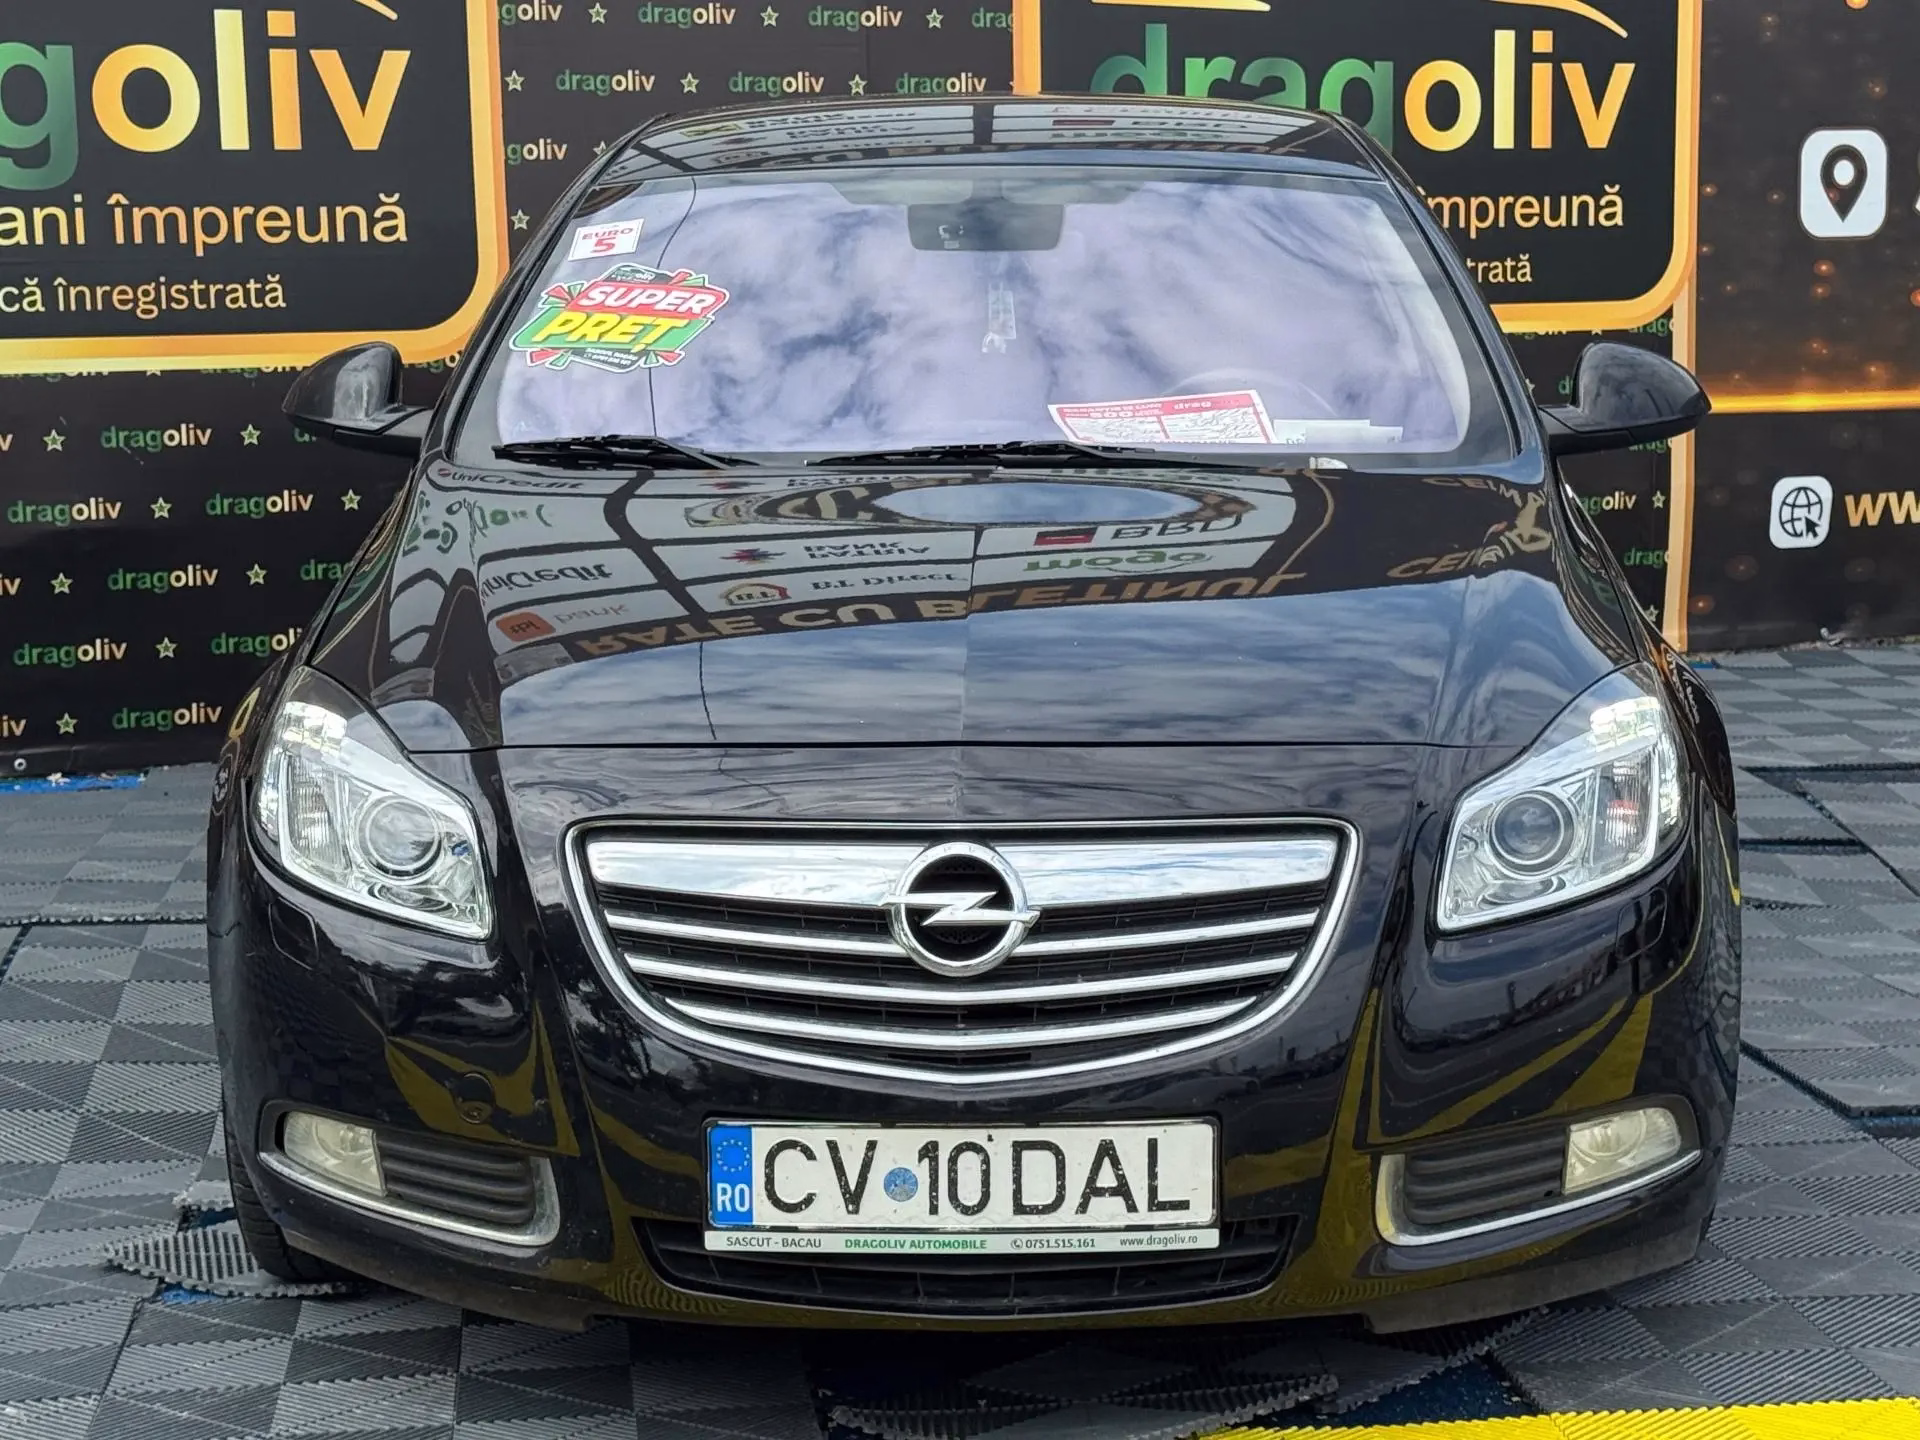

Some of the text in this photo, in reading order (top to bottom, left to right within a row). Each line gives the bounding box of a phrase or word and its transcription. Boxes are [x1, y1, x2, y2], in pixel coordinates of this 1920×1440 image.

[498, 0, 563, 25] goliv
[638, 4, 735, 29] dragoliv
[808, 4, 903, 30] dragoliv
[555, 69, 655, 96] dragoliv
[728, 71, 824, 97] dragoliv
[894, 72, 987, 95] dragoliv
[503, 138, 568, 165] goliv
[107, 192, 408, 256] împreună
[1416, 184, 1624, 240] mpreună
[582, 227, 634, 241] EURO
[590, 236, 617, 254] 5
[56, 274, 287, 318] înregistrată
[577, 285, 718, 315] SUPER
[100, 423, 212, 452] dragoliv
[7, 497, 122, 526] dragoliv
[205, 489, 314, 518] dragoliv
[107, 564, 218, 593] dragoliv
[13, 638, 128, 668] dragoliv
[112, 702, 222, 731] dragoliv
[763, 1137, 1191, 1216] CV 10 DAL
[716, 1183, 750, 1214] RO
[726, 1237, 773, 1250] SASCUT
[782, 1237, 822, 1250] BACAU
[844, 1238, 988, 1251] DRAGOLIV AUTOMOBILE
[1025, 1237, 1096, 1250] 0751.515.161
[1119, 1234, 1199, 1248] www.dragoliv.ro
